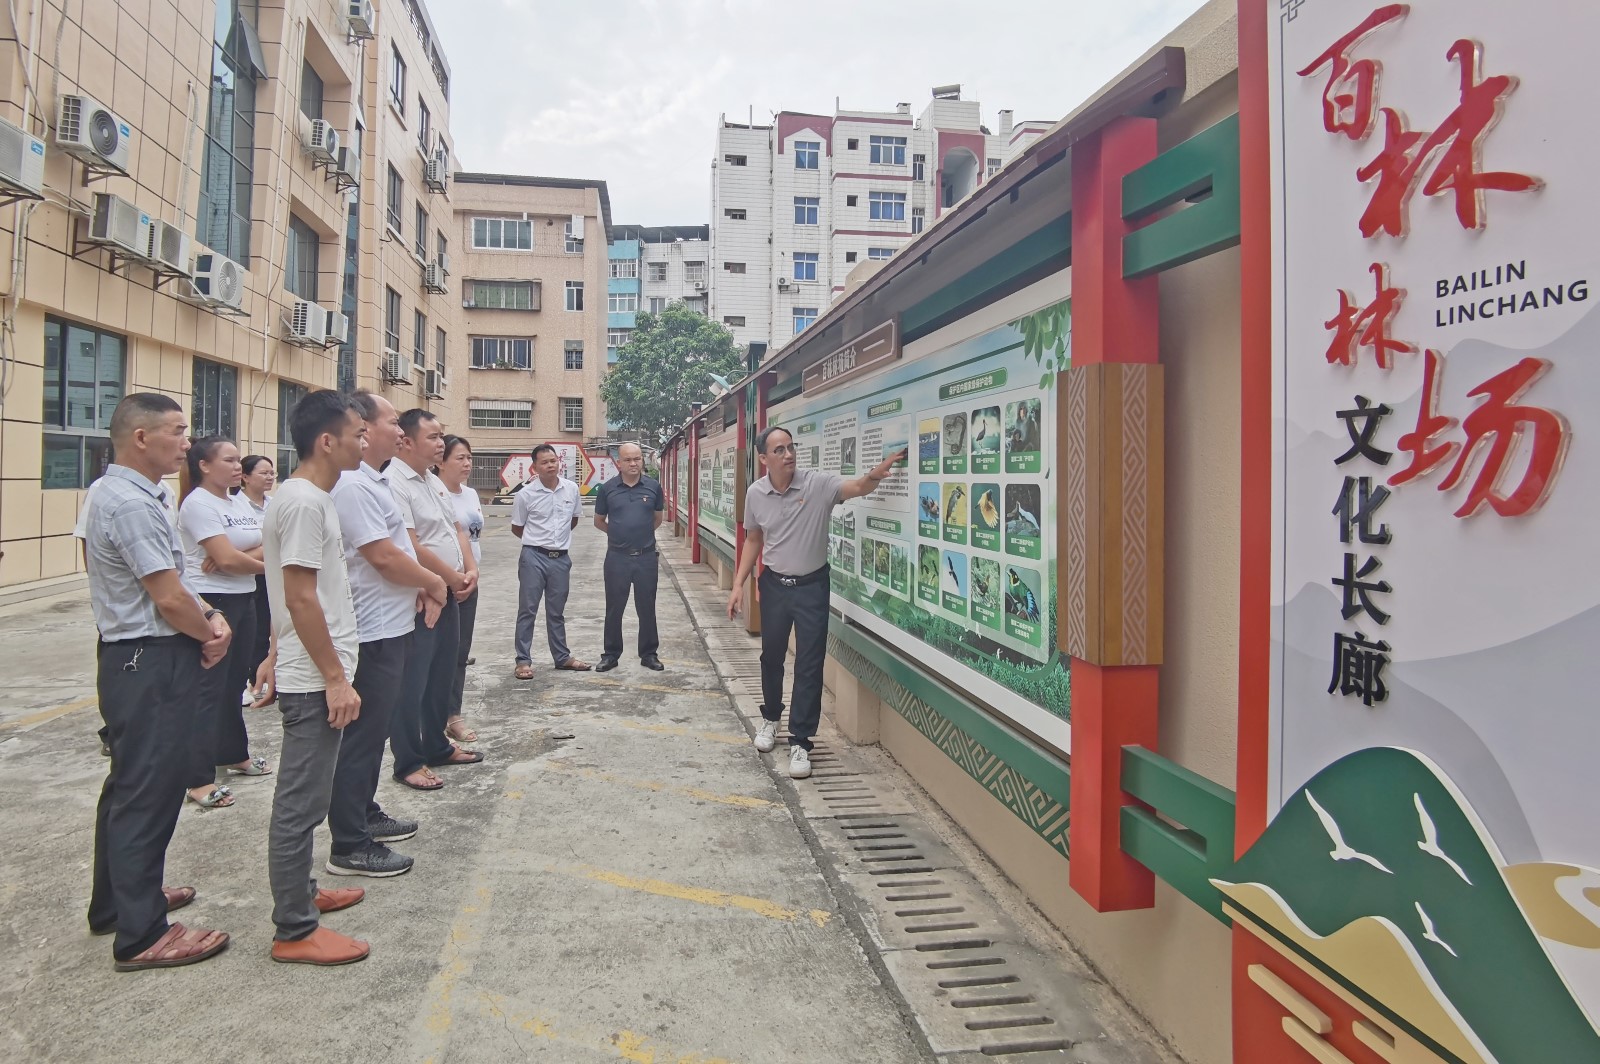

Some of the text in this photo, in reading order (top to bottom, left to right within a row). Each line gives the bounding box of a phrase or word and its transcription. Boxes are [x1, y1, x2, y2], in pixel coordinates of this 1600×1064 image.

[1436, 260, 1525, 298] BAILIN
[1436, 280, 1588, 327] LINCHANG
[1327, 394, 1394, 708] 文化长廊
